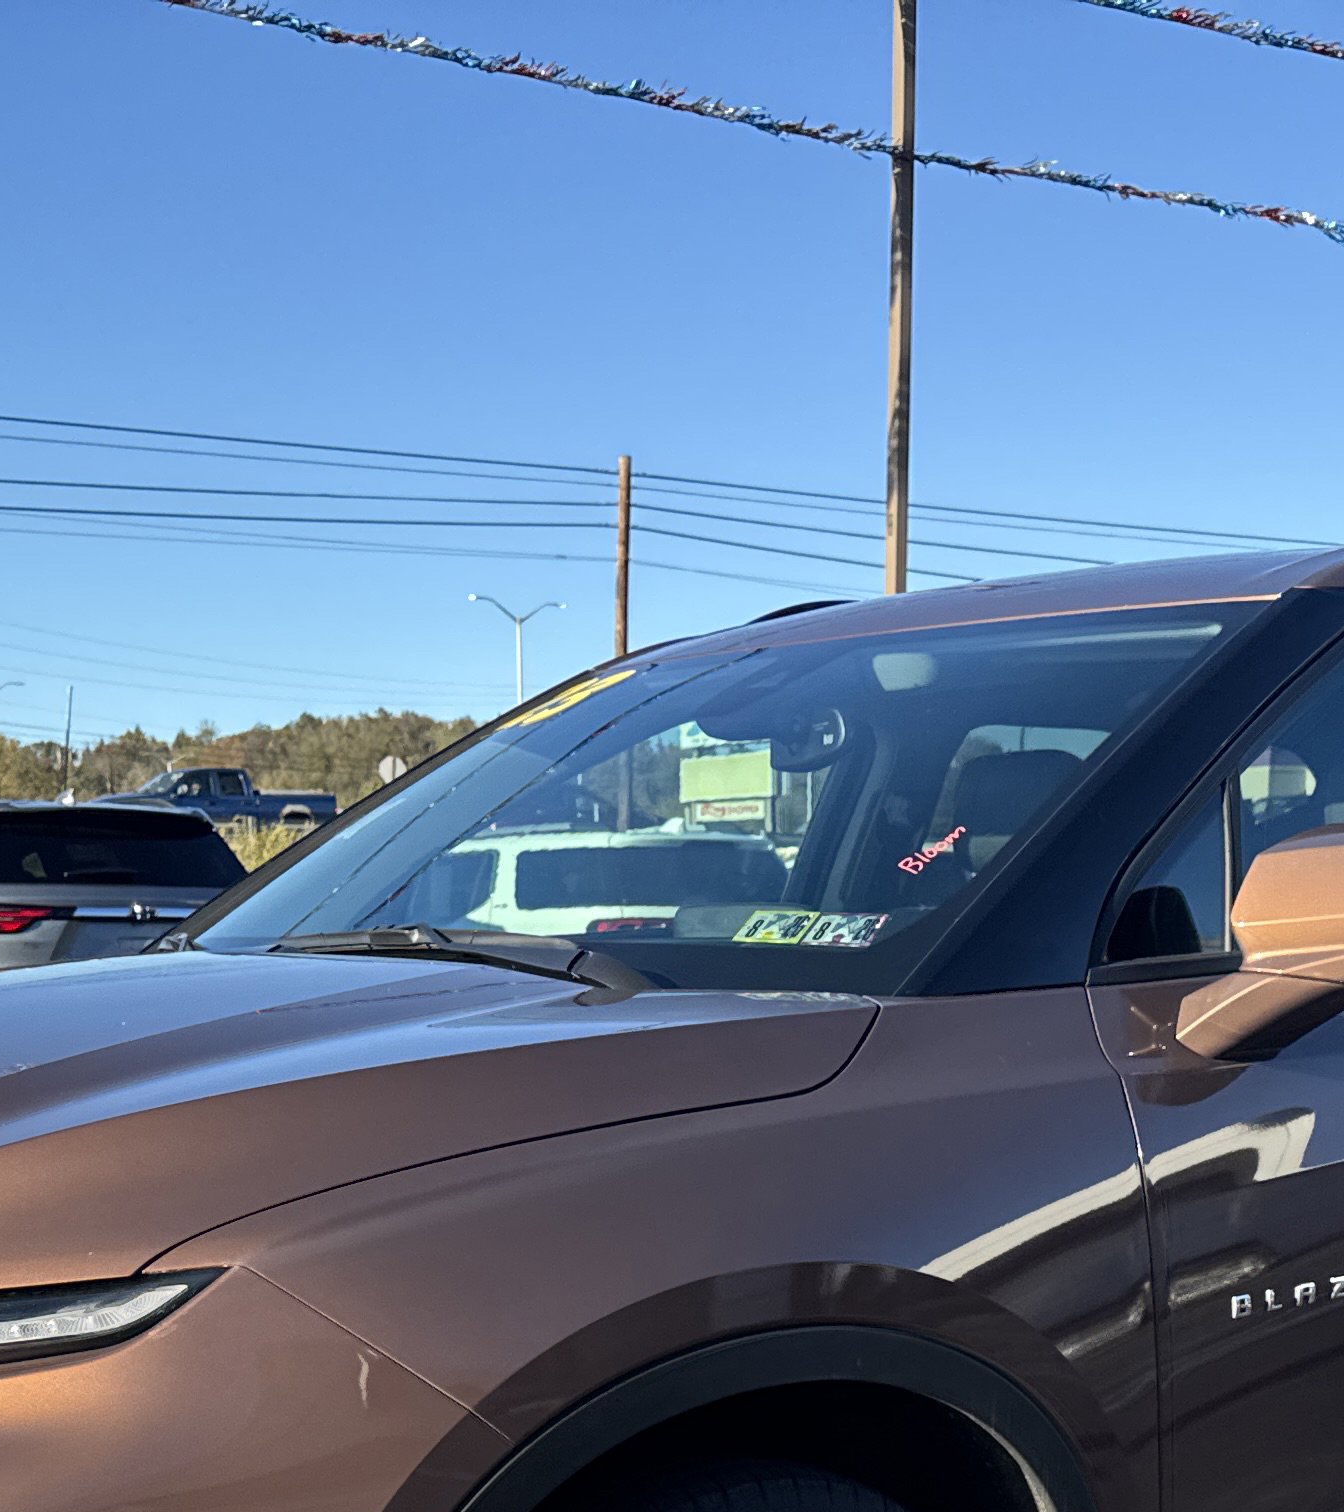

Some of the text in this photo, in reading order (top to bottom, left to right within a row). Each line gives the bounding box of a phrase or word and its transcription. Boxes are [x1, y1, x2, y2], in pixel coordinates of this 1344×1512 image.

[897, 826, 967, 875] Bloom
[745, 919, 765, 938] 8
[812, 921, 832, 941] 8
